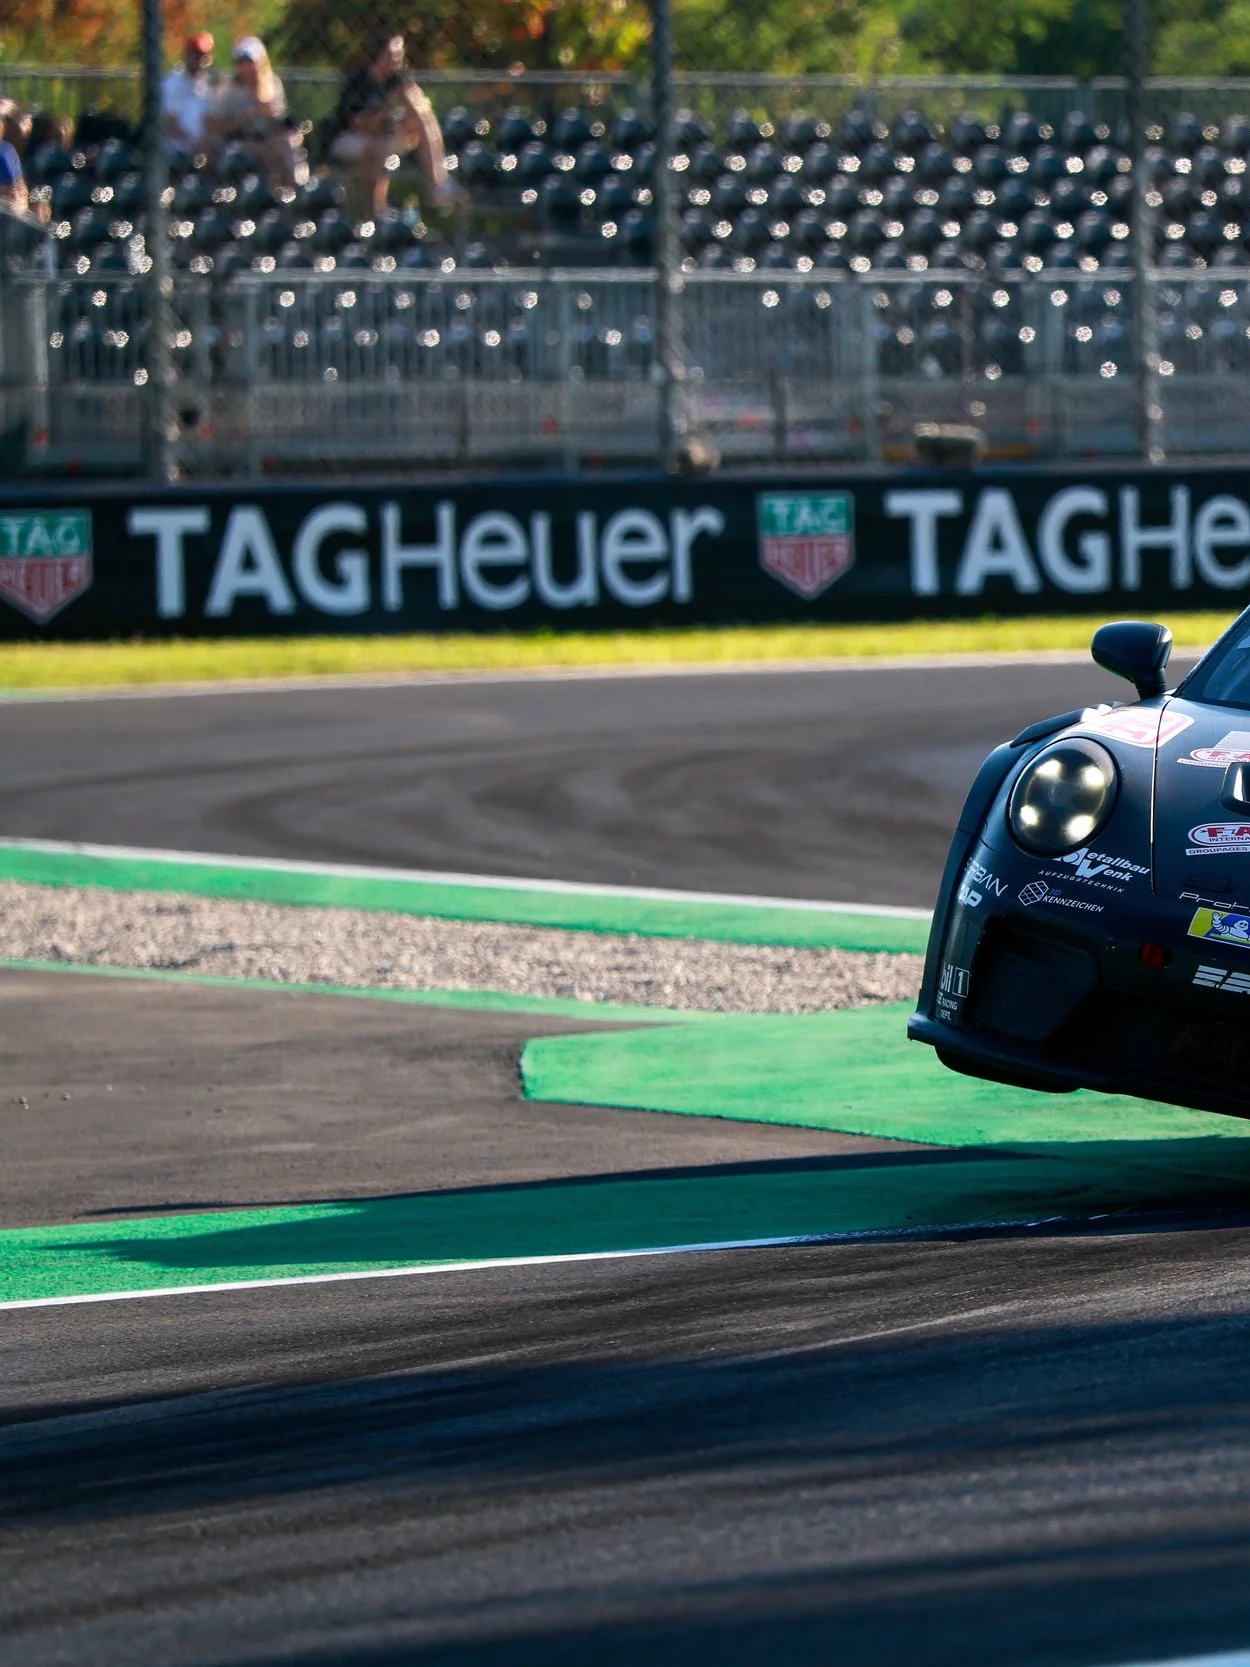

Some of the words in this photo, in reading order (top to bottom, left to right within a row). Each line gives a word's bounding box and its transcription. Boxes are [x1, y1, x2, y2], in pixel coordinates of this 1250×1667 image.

[1188, 846, 1248, 854] GROUPAGES
[1075, 859, 1134, 881] Wenk
[1038, 869, 1125, 893] AUFZUGSTECHNIK
[1043, 895, 1104, 912] KENNZEICHEN
